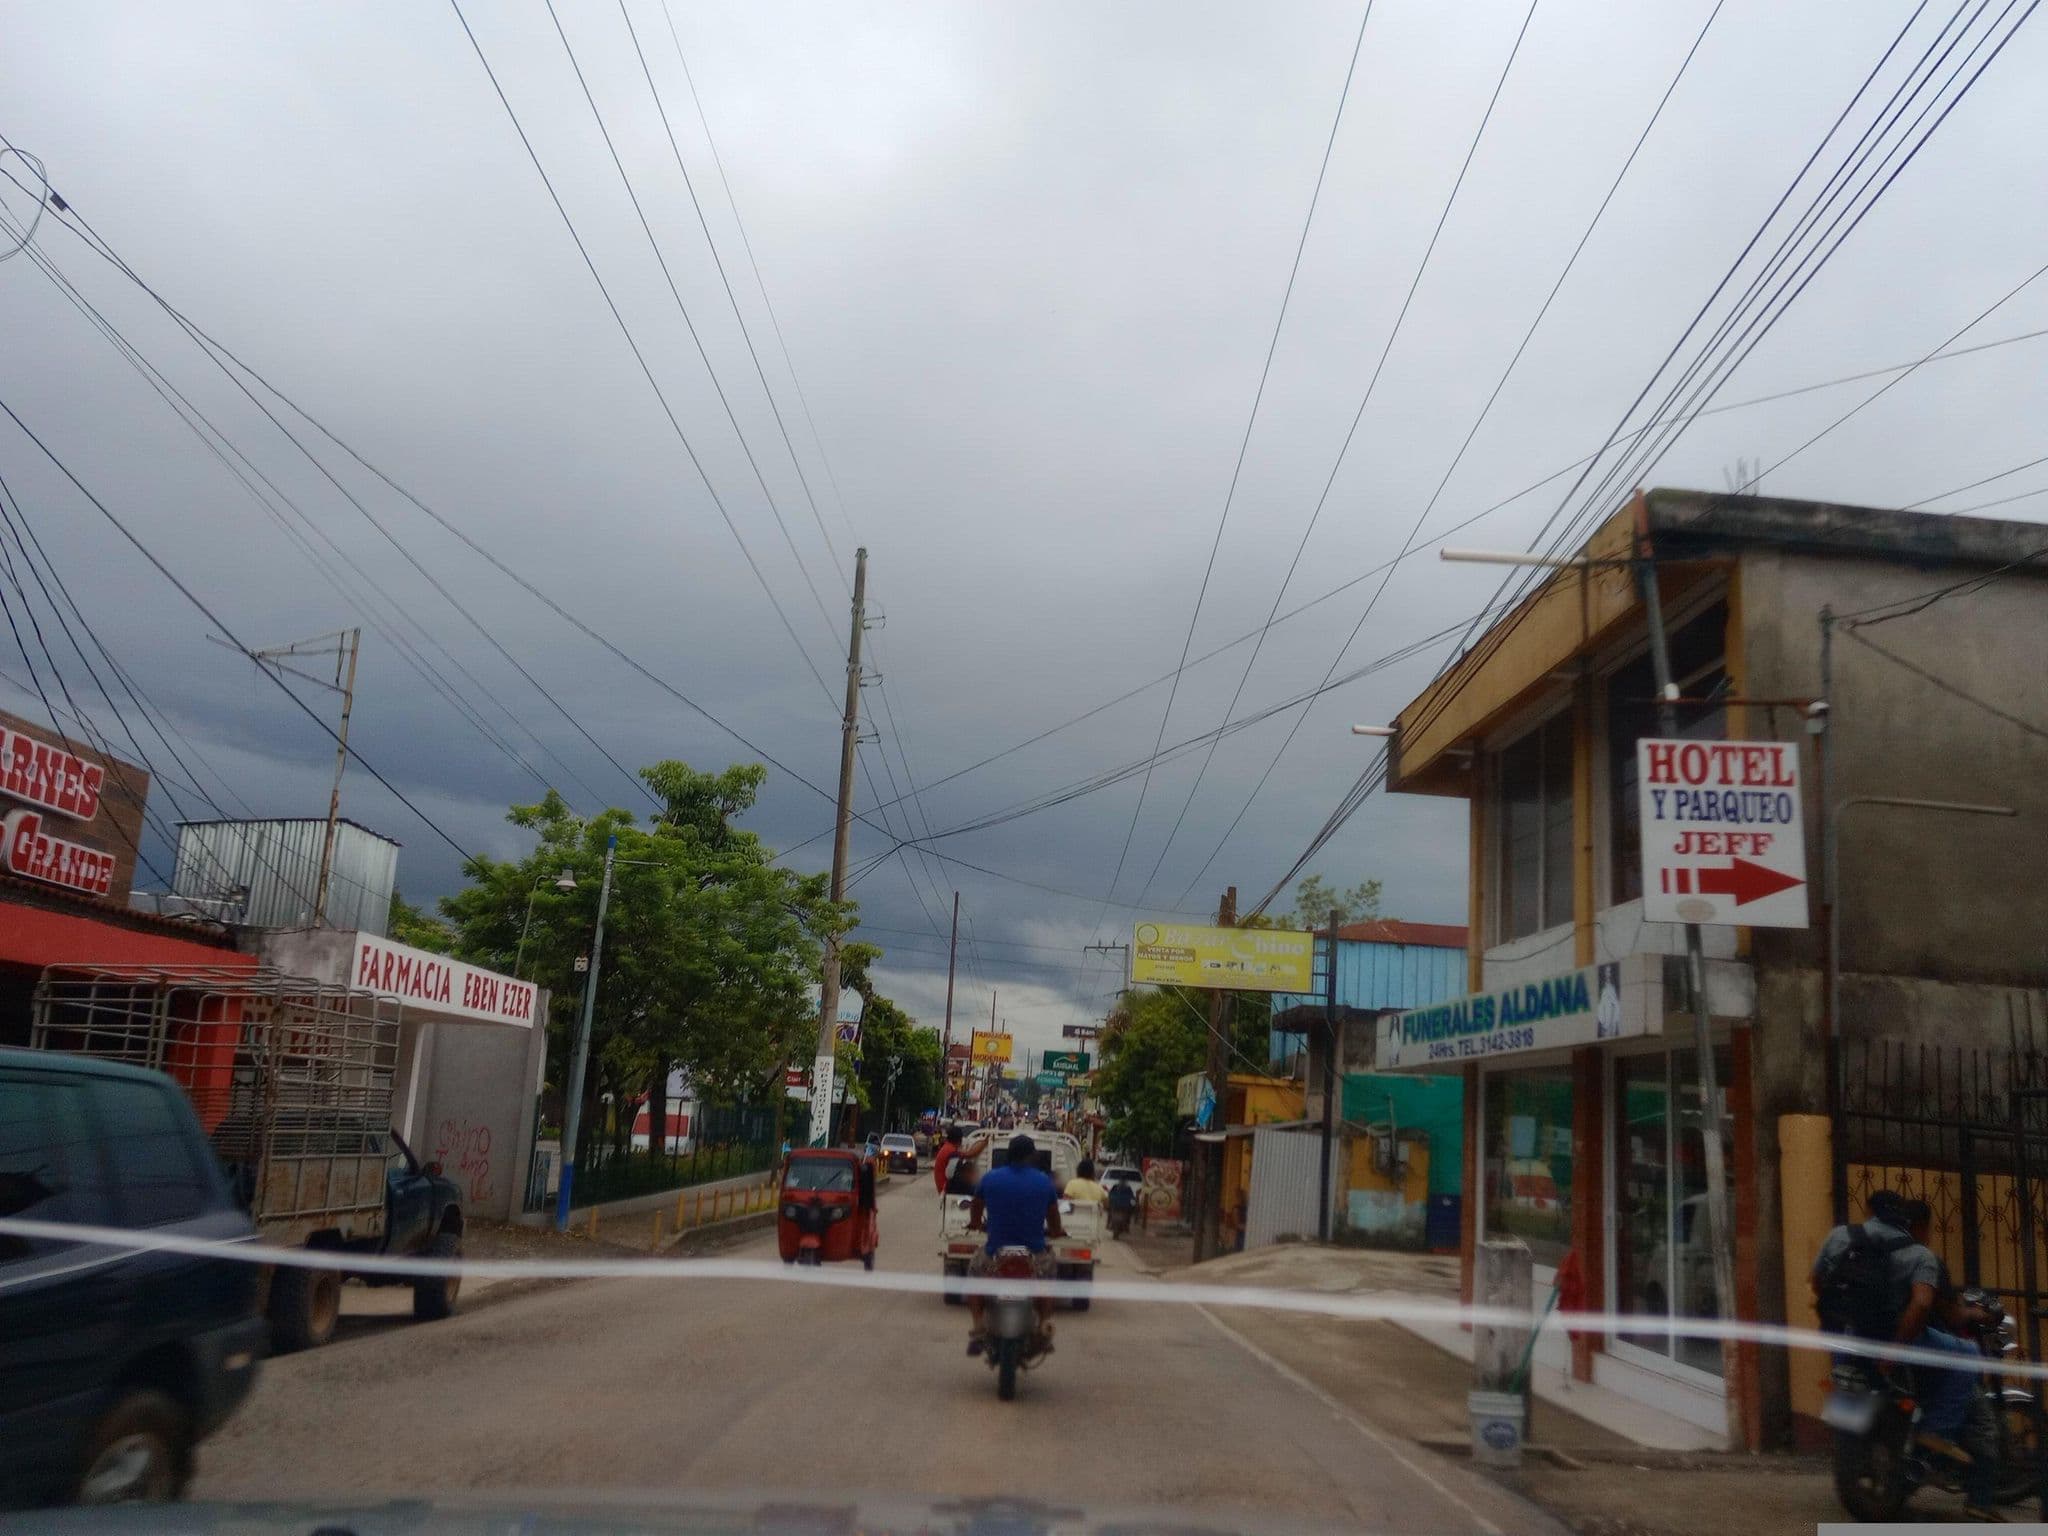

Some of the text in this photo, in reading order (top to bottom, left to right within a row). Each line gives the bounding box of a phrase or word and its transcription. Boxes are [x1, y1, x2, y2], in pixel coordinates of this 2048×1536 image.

[1647, 743, 1795, 787] HOTEL
[1652, 789, 1793, 825] Y PARQUEO
[1674, 831, 1774, 856] JEFF
[357, 944, 532, 1020] FARMACIA EBEN EZER
[1403, 971, 1591, 1046] FUNERALES ALDANA
[973, 1053, 1010, 1064] MODERNA
